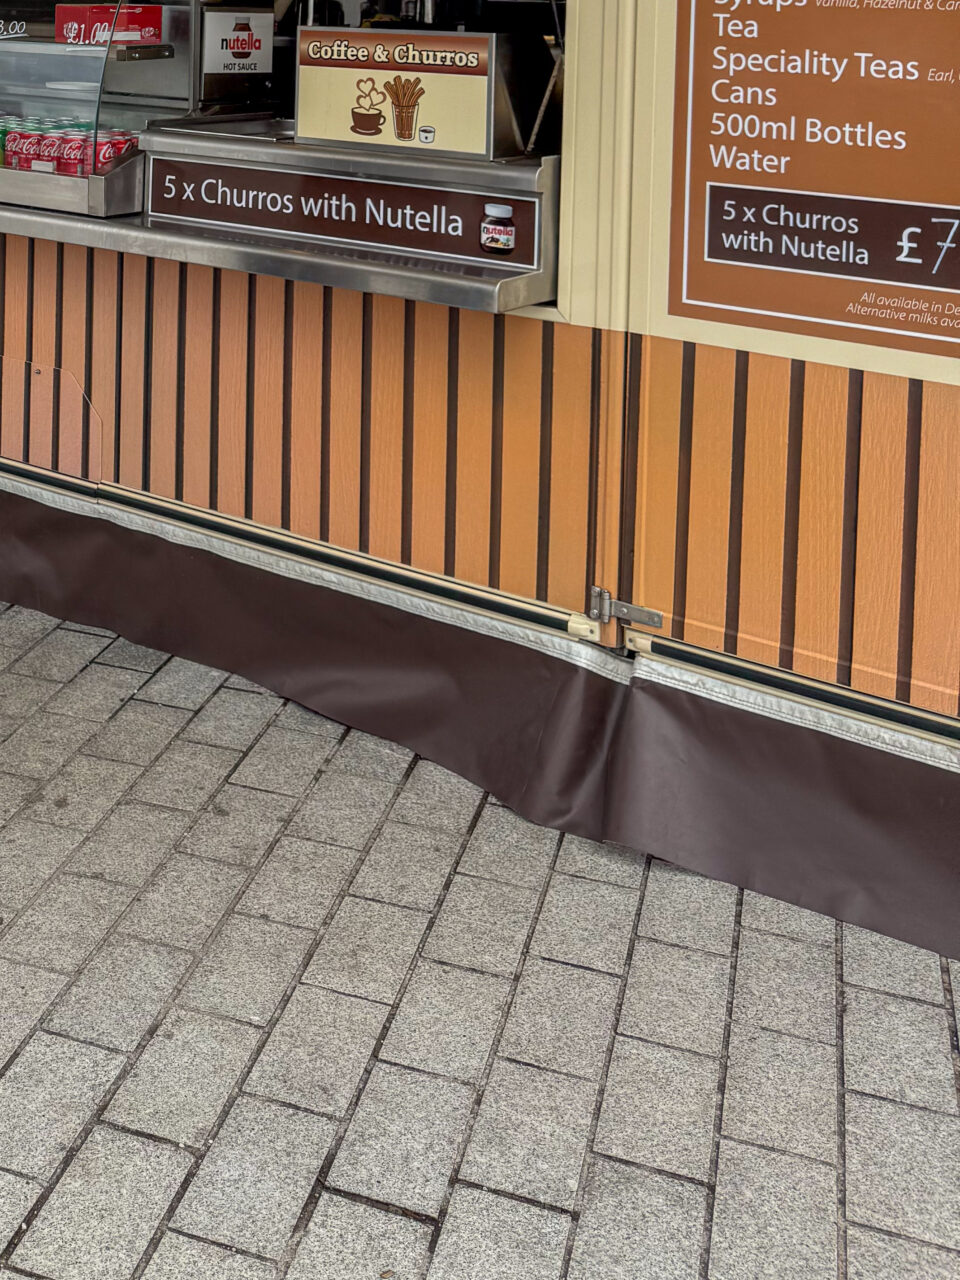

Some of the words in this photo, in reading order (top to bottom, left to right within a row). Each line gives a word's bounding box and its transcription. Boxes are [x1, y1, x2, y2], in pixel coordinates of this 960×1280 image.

[67, 22, 109, 45] £1.00
[713, 14, 758, 39] Tea
[221, 31, 262, 51] nutella
[307, 41, 369, 61] Coffee
[374, 44, 390, 63] &
[393, 44, 479, 67] Churros
[223, 63, 237, 71] HOT
[238, 63, 258, 71] SAUCE
[712, 47, 848, 82] Speciality
[854, 52, 919, 80] Teas
[927, 68, 955, 84] Earl,
[712, 79, 777, 106] Cans
[710, 113, 796, 141] 500ml
[805, 119, 907, 150] Bottles
[709, 144, 790, 174] Water
[163, 175, 176, 199] 5
[182, 185, 195, 201] x
[200, 179, 293, 213] Churros
[301, 192, 356, 223] with
[365, 198, 463, 236] Nutella
[722, 200, 736, 220] 5
[742, 207, 756, 223] x
[762, 204, 859, 234] Churros
[482, 226, 513, 236] nutella
[721, 230, 773, 254] with
[781, 235, 869, 265] Nutella
[845, 302, 906, 321] Alternative
[908, 313, 938, 325] milks
[860, 292, 876, 303] All
[877, 296, 929, 312] available
[931, 301, 942, 312] in
